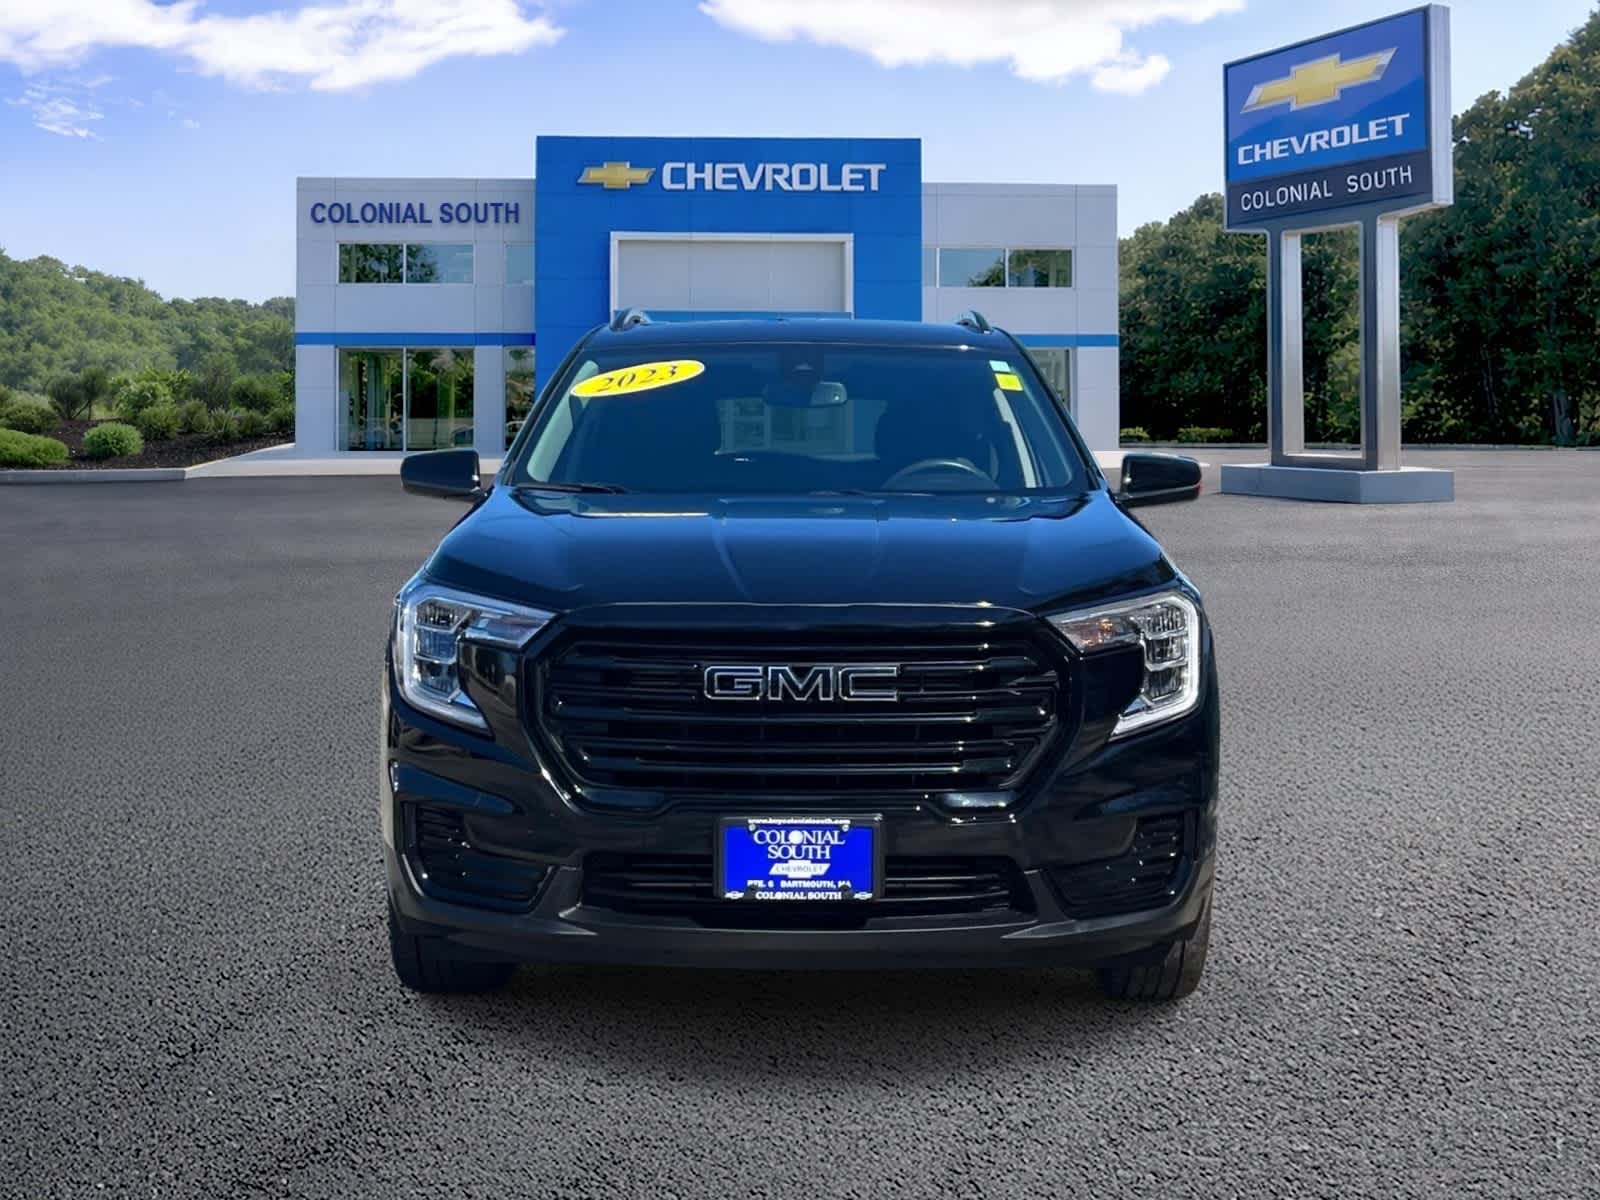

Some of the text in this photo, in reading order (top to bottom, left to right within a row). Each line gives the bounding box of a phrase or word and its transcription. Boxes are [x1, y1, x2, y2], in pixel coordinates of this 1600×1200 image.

[1237, 113, 1410, 165] CHEVROLET
[662, 162, 887, 192] CHEVROLET
[1240, 165, 1412, 212] COLONIAL SOUTH
[310, 202, 520, 224] COLONIAL SOUTH
[596, 365, 678, 392] 2023
[704, 666, 898, 701] GMC
[753, 830, 846, 845] COLONIAL
[767, 845, 831, 859] SOUTH
[775, 864, 823, 873] CHEVROLET
[755, 891, 842, 900] COLONIAL SOUTH
[780, 880, 836, 889] DARTMOUTH,
